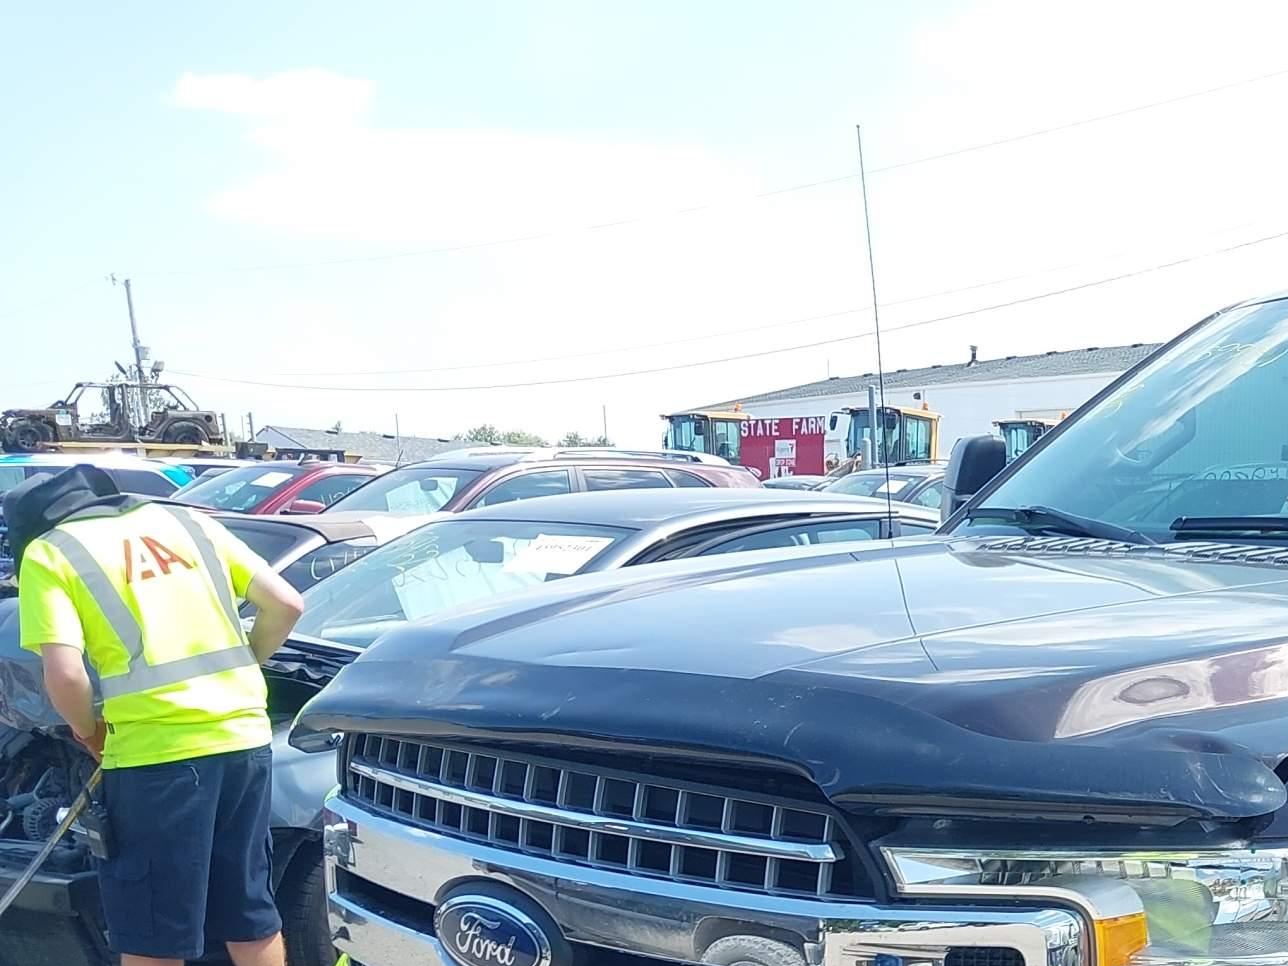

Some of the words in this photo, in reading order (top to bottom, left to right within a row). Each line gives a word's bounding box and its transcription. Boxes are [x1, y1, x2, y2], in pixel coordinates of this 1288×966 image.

[740, 420, 780, 437] STATE
[792, 417, 825, 436] FARM
[456, 911, 516, 966] Ford
